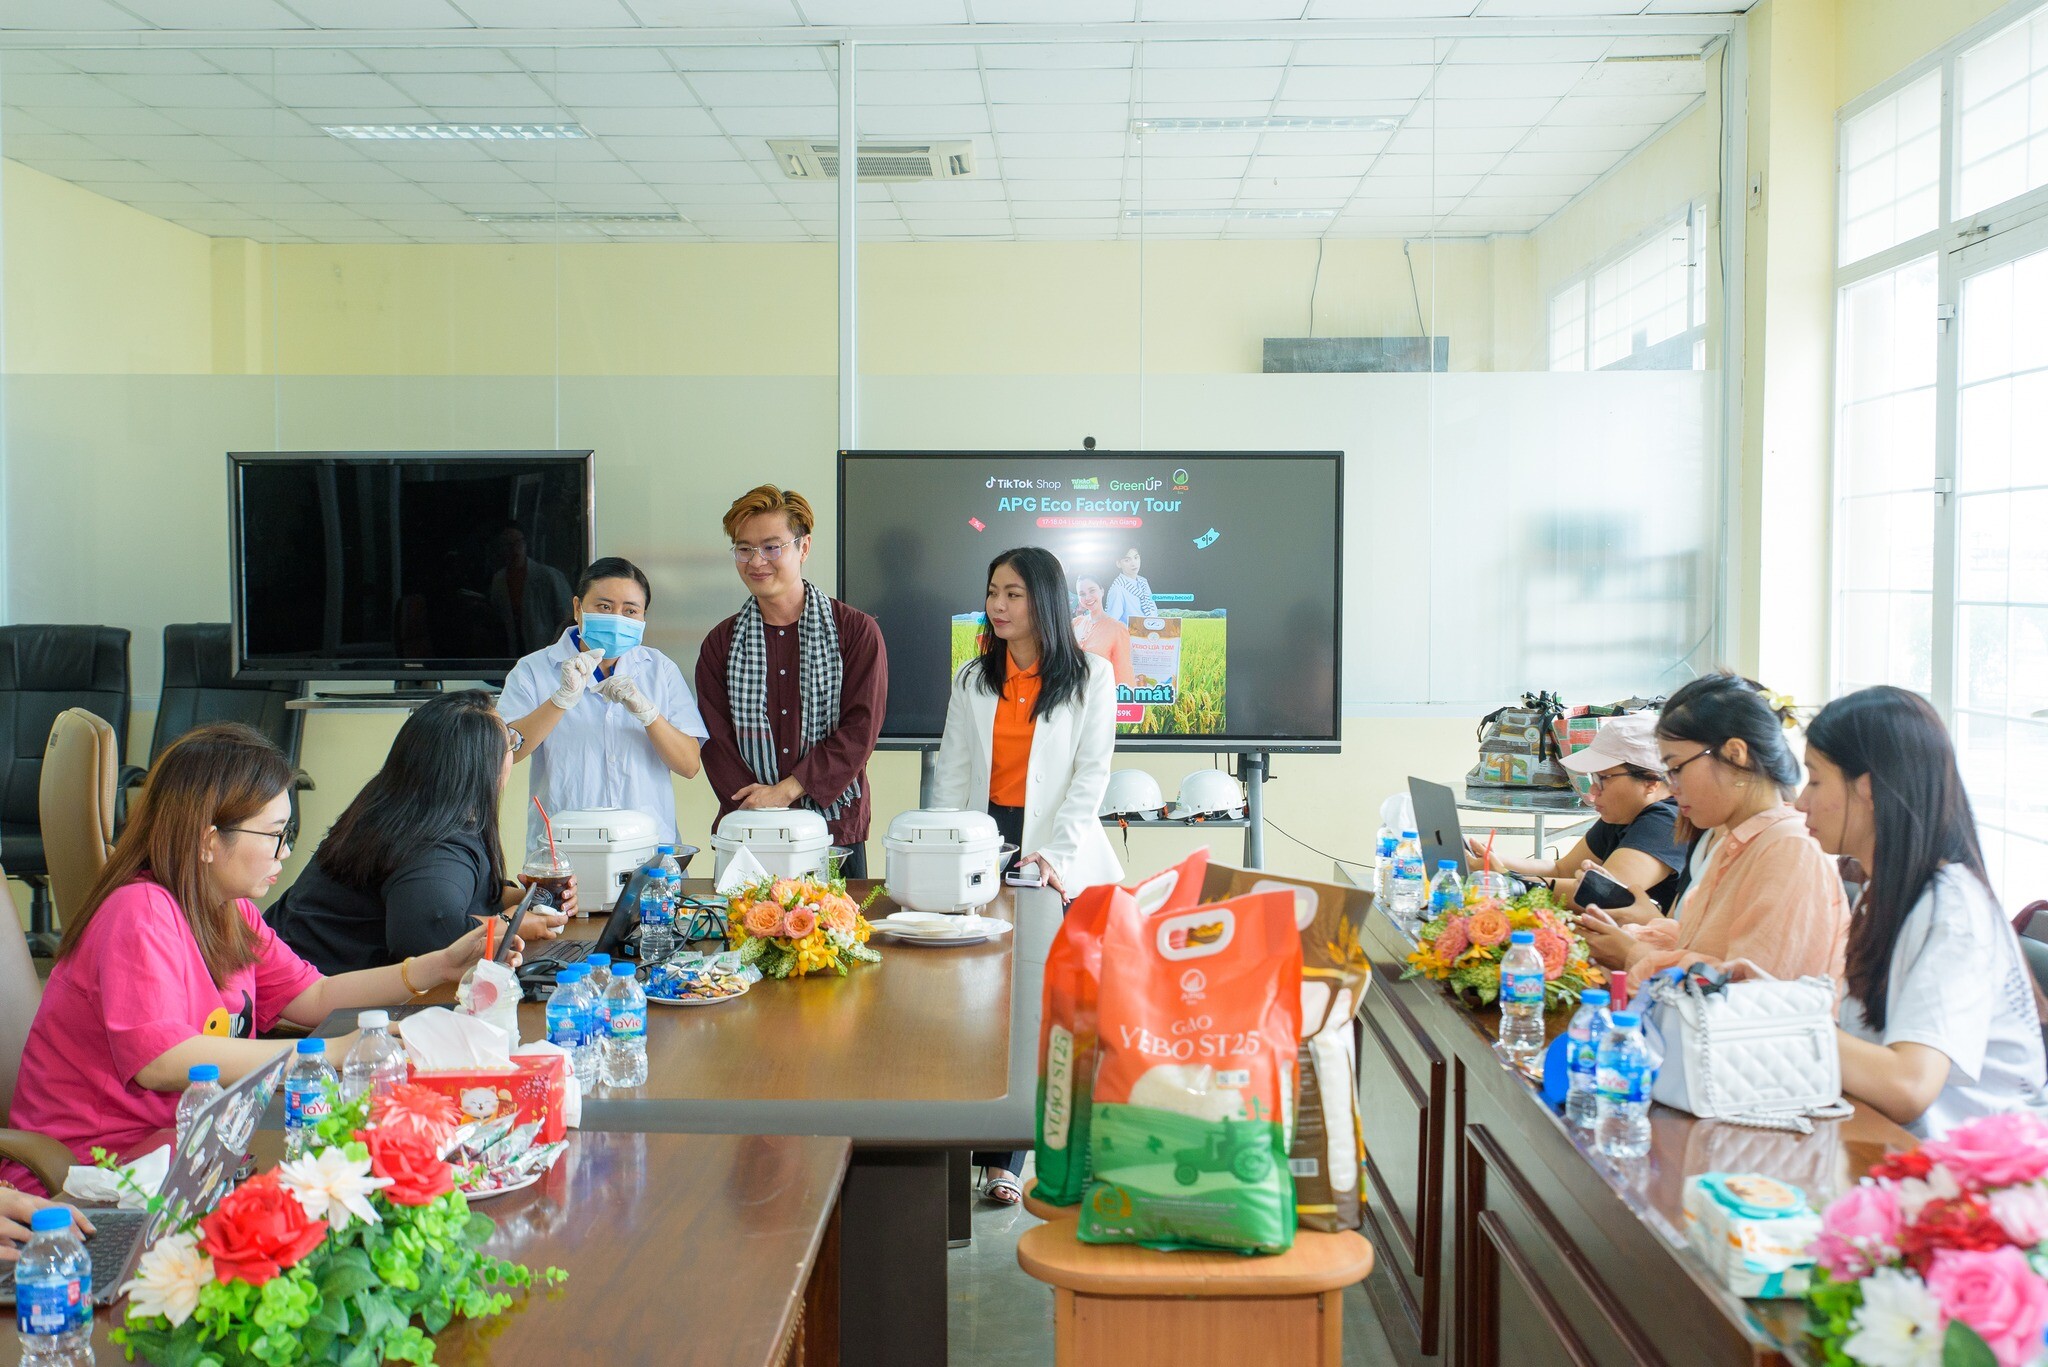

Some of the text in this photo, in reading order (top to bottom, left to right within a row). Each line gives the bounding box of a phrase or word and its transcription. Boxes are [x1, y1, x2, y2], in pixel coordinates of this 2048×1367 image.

[998, 479, 1061, 490] TikTok Shop
[1110, 478, 1163, 491] GreenUP
[998, 497, 1182, 516] APG Eco Factory Tour
[1135, 685, 1172, 702] mát
[612, 1016, 642, 1029] laVie
[1198, 1030, 1261, 1058] ST25
